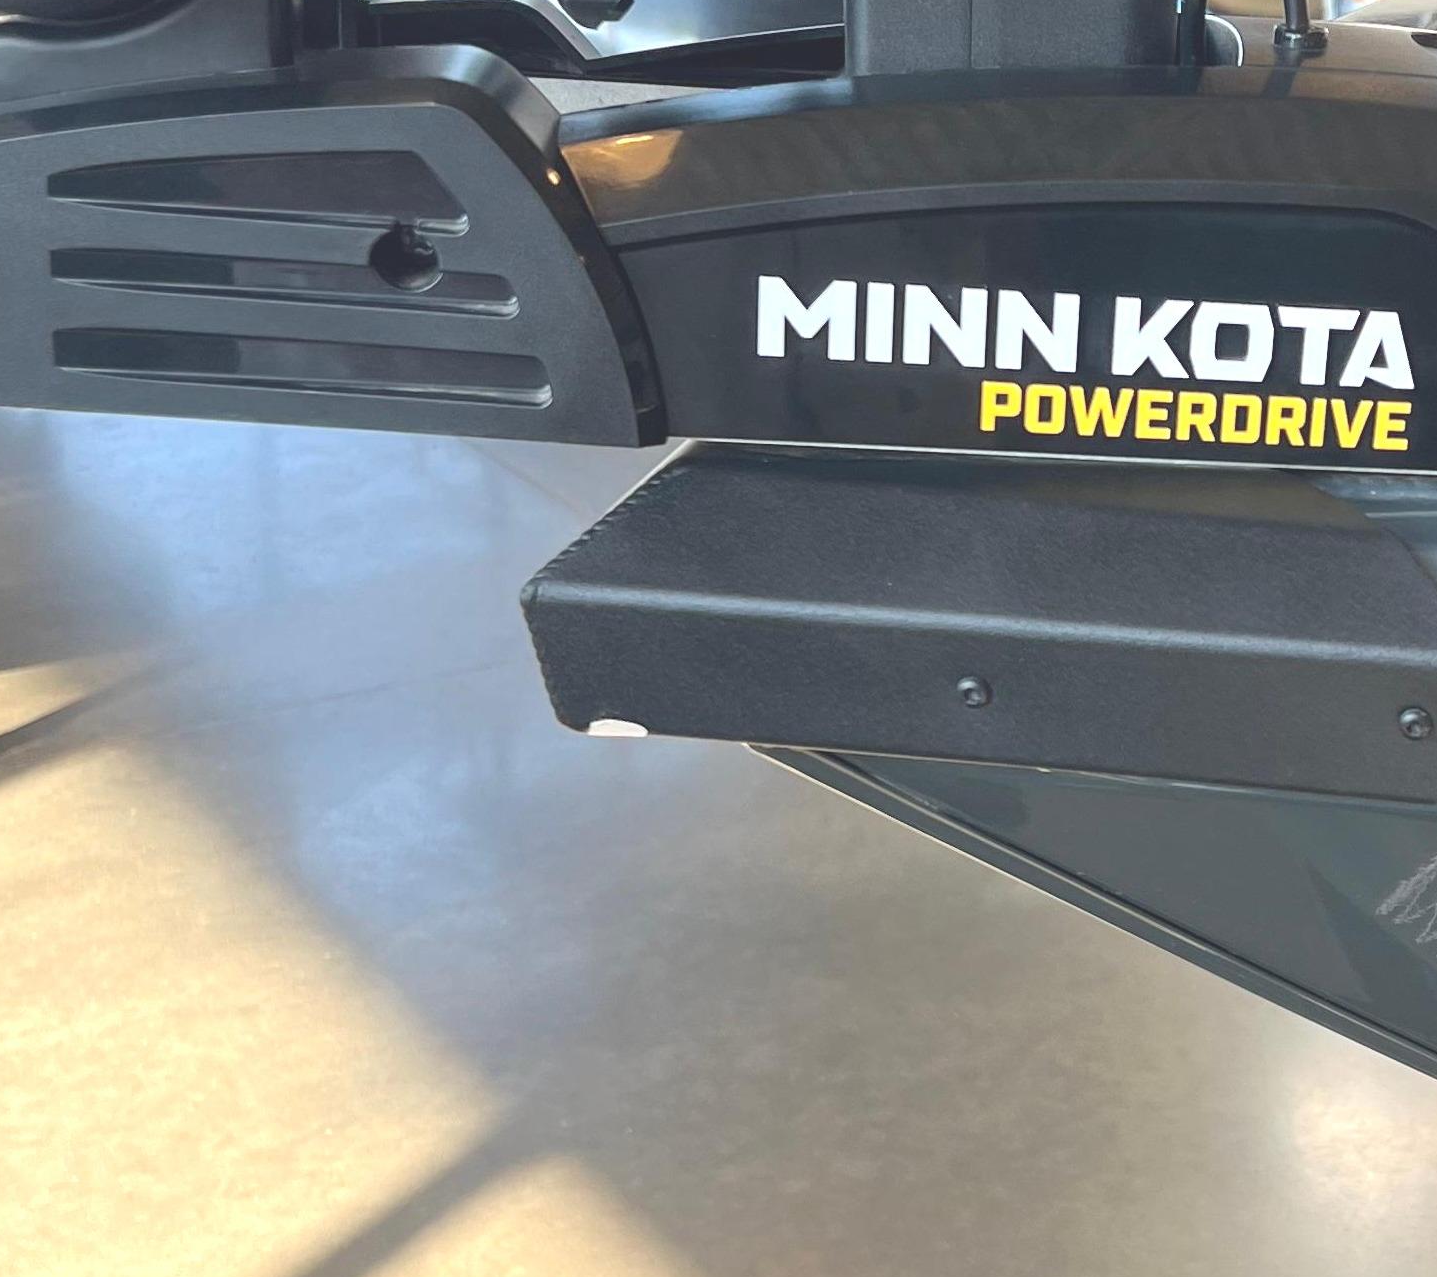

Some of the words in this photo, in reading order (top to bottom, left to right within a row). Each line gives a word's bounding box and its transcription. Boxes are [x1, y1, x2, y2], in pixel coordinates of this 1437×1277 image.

[757, 275, 1081, 374] MINN
[1110, 295, 1416, 390] KOTA
[979, 380, 1414, 451] POWERDRIVE
